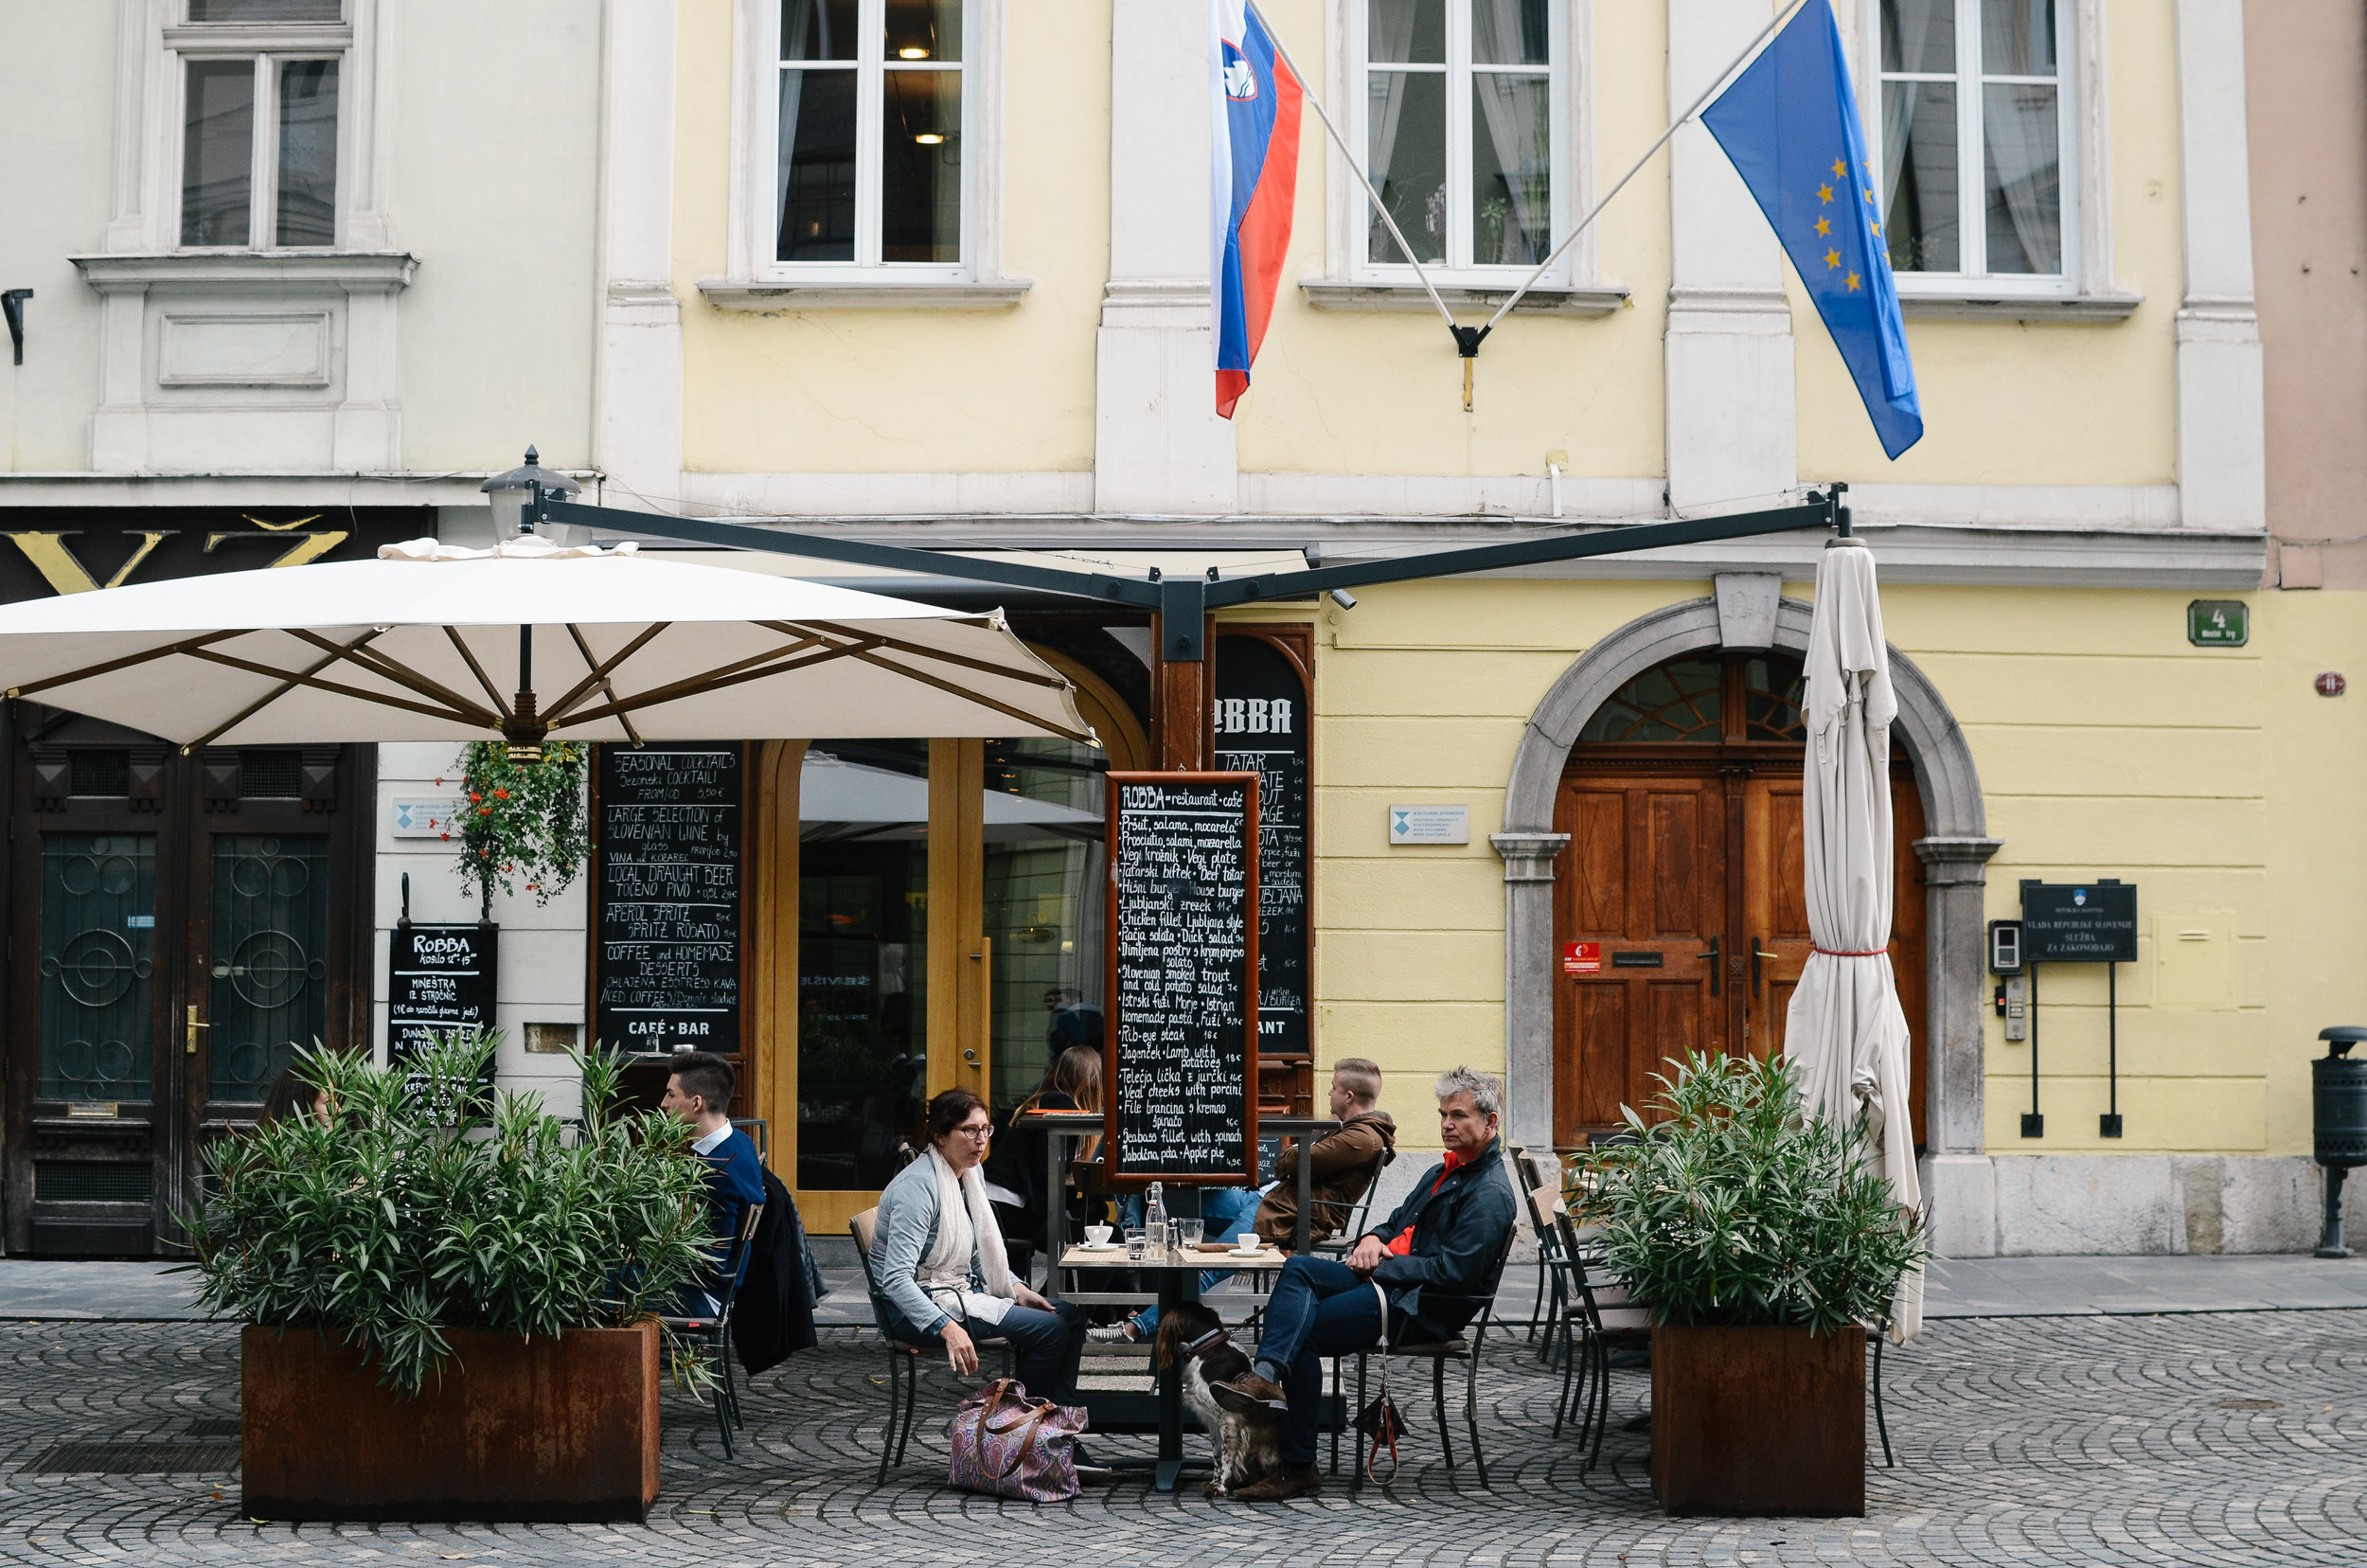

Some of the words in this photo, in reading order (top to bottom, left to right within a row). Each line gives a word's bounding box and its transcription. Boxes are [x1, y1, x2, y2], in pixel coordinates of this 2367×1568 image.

[2213, 609, 2226, 629] 4
[615, 755, 674, 772] SEASONAL
[681, 754, 736, 769] COCKTAILS
[1225, 753, 1267, 772] TATAR
[1122, 785, 1165, 810] ROBBA
[1171, 788, 1218, 806] restaurant
[1222, 791, 1243, 808] café
[608, 807, 646, 823] LARGE
[652, 807, 709, 823] SELECTION
[714, 809, 725, 823] of
[1258, 805, 1285, 825] AGE
[608, 824, 671, 840] SLOVENIAN
[679, 825, 708, 841] WINE
[717, 828, 729, 846] by
[610, 852, 632, 863] VINA
[1122, 846, 1142, 866] Vegi
[1187, 849, 1207, 869] Vegi
[1212, 850, 1237, 869] plate
[608, 865, 641, 882] LOCAL
[649, 864, 700, 885] DRAUGHT
[704, 866, 734, 885] BEER
[1120, 863, 1158, 878] Tatarski
[1163, 863, 1191, 879] biftek
[1201, 864, 1220, 881] Beef
[1222, 865, 1245, 882] tatar
[667, 882, 690, 898] PIVO
[1122, 879, 1147, 894] Hišni
[1218, 882, 1245, 904] burger
[606, 905, 648, 922] APEROL
[653, 905, 690, 921] SPRITZ
[1121, 895, 1174, 916] Ljubljanski
[1180, 899, 1211, 912] zrezek
[628, 922, 668, 938] SPRITZ
[676, 922, 720, 939] ROSATO
[1121, 911, 1157, 926] Chicken
[1159, 911, 1183, 927] fillet
[1186, 913, 1224, 934] Ljubljana
[1226, 914, 1244, 934] style
[1181, 928, 1203, 943] Duck
[1208, 929, 1234, 944] salad
[607, 946, 650, 960] COFFEE
[657, 948, 671, 960] and
[675, 945, 734, 961] HOMEMADE
[1163, 942, 1191, 962] postrv
[640, 962, 699, 976] DESSERTS
[1166, 956, 1193, 969] solato
[1121, 964, 1161, 979] Slovenian
[1166, 966, 1196, 981] smoked
[1201, 968, 1230, 982] trout
[412, 975, 456, 991] MINEŠTRA
[714, 978, 737, 989] KAVA
[1123, 980, 1139, 990] and
[1144, 980, 1161, 991] cold
[1165, 981, 1192, 996] potato
[1198, 983, 1223, 996] salad
[1122, 992, 1150, 1007] Istrski
[1175, 994, 1198, 1014] Morje
[1206, 997, 1235, 1012] Istrian
[629, 1019, 666, 1035] CAFÉ
[678, 1023, 709, 1035] BAR
[1168, 1010, 1193, 1028] pasta
[1122, 1025, 1156, 1050] Rib-eye
[1161, 1027, 1184, 1042] steak
[1166, 1043, 1189, 1060] Lamb
[1194, 1043, 1216, 1059] with
[1181, 1058, 1220, 1072] potatoes
[1120, 1068, 1153, 1088] Telečja
[1156, 1067, 1182, 1082] lička
[1187, 1072, 1193, 1082] z
[1124, 1083, 1144, 1099] Veal
[1148, 1083, 1181, 1097] cheeks
[1185, 1082, 1206, 1096] with
[1211, 1083, 1243, 1098] porcini
[1124, 1099, 1142, 1114] File
[1146, 1099, 1184, 1114] brancina
[1196, 1098, 1227, 1114] kremno
[1160, 1129, 1185, 1143] fillet
[1190, 1129, 1211, 1143] with
[1214, 1128, 1242, 1146] spinach
[1184, 1144, 1208, 1164] Apple
[1211, 1147, 1225, 1165] pie
